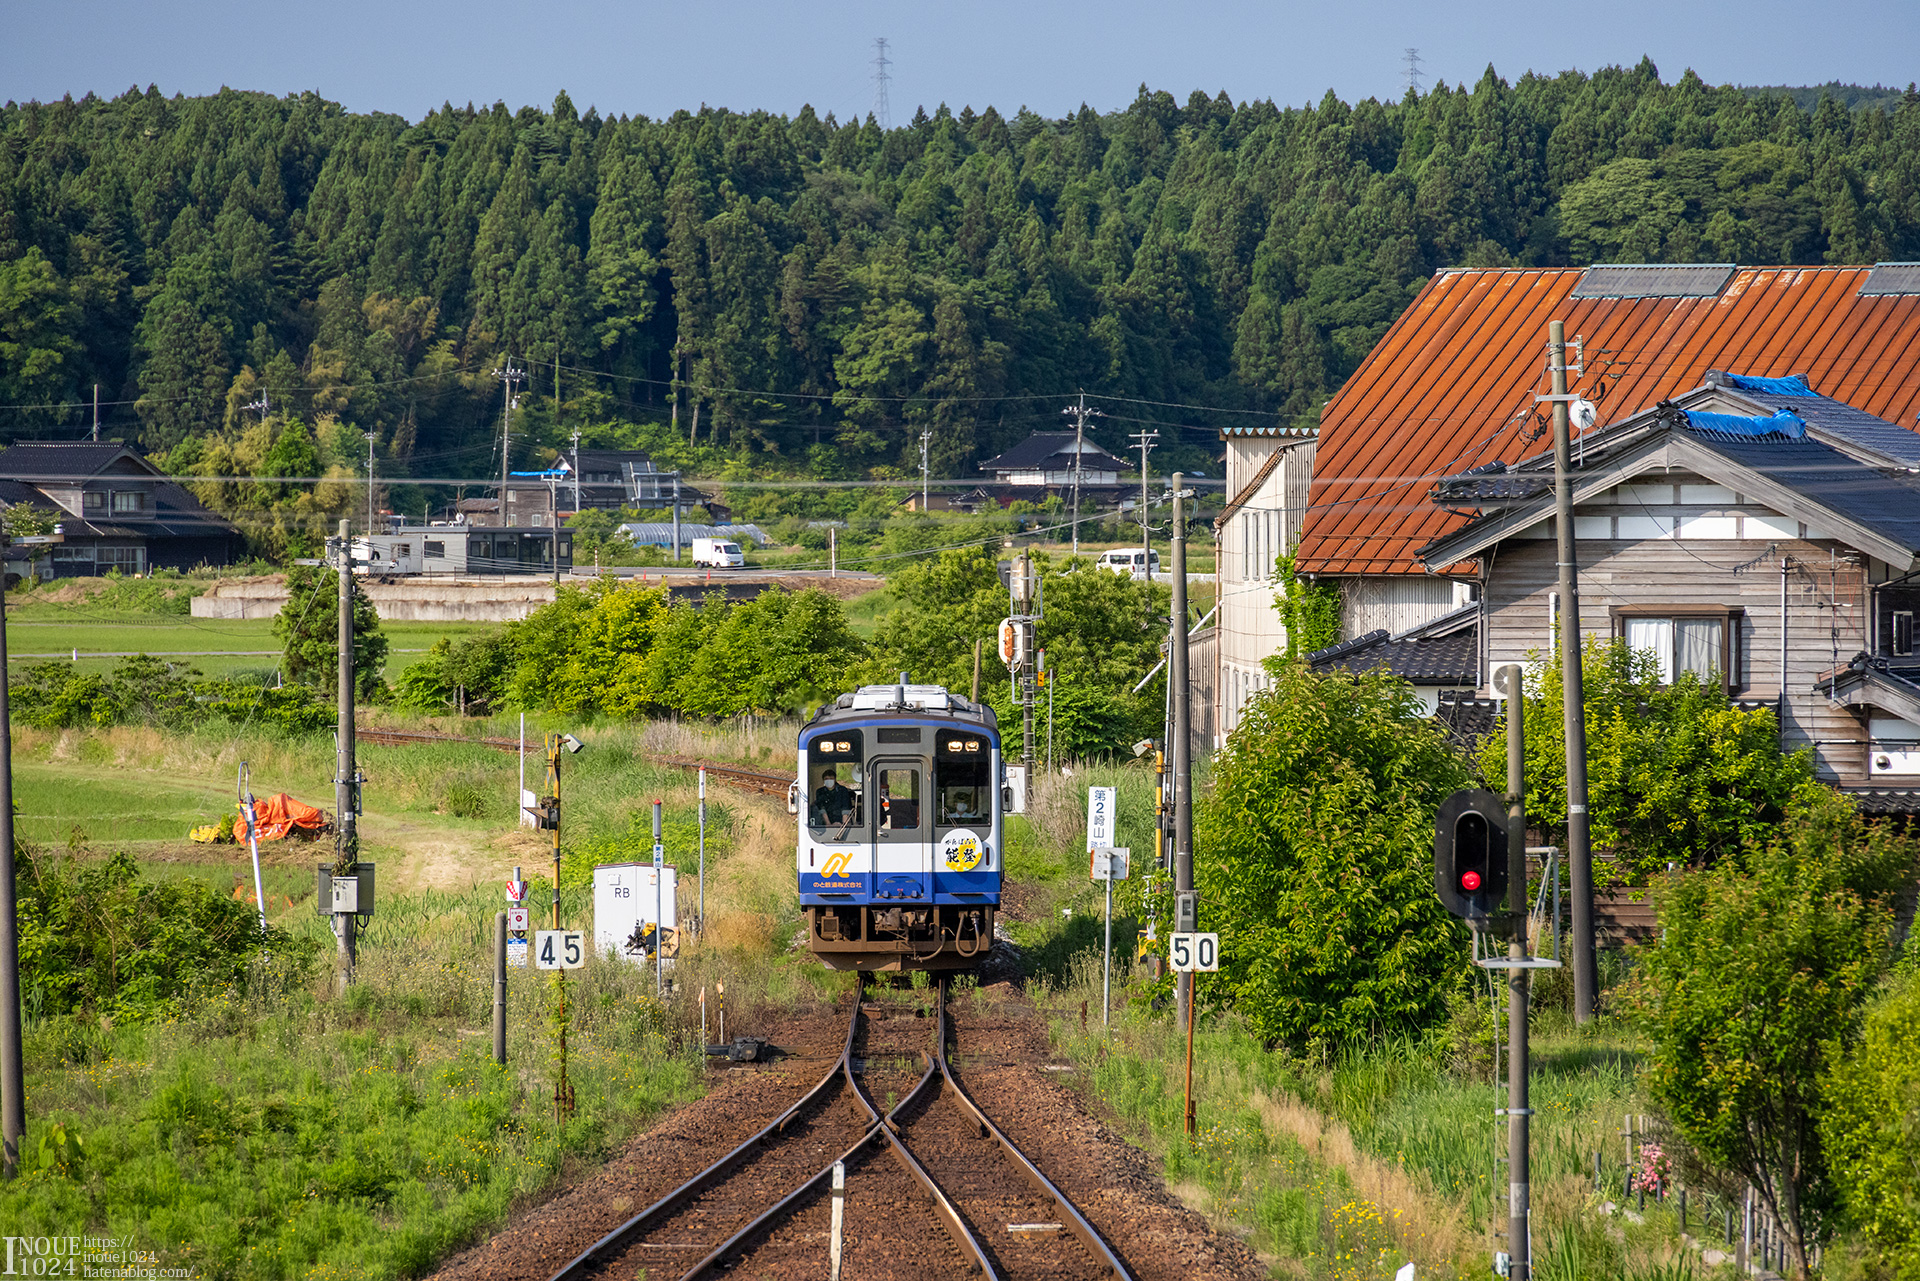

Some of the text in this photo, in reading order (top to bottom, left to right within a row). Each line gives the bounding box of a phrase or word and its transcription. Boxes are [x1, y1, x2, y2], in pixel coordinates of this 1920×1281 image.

[1093, 790, 1106, 839] 第2崎山
[945, 847, 976, 863] 能登
[614, 887, 630, 898] RB
[540, 935, 580, 965] 45
[1174, 937, 1214, 967] 50
